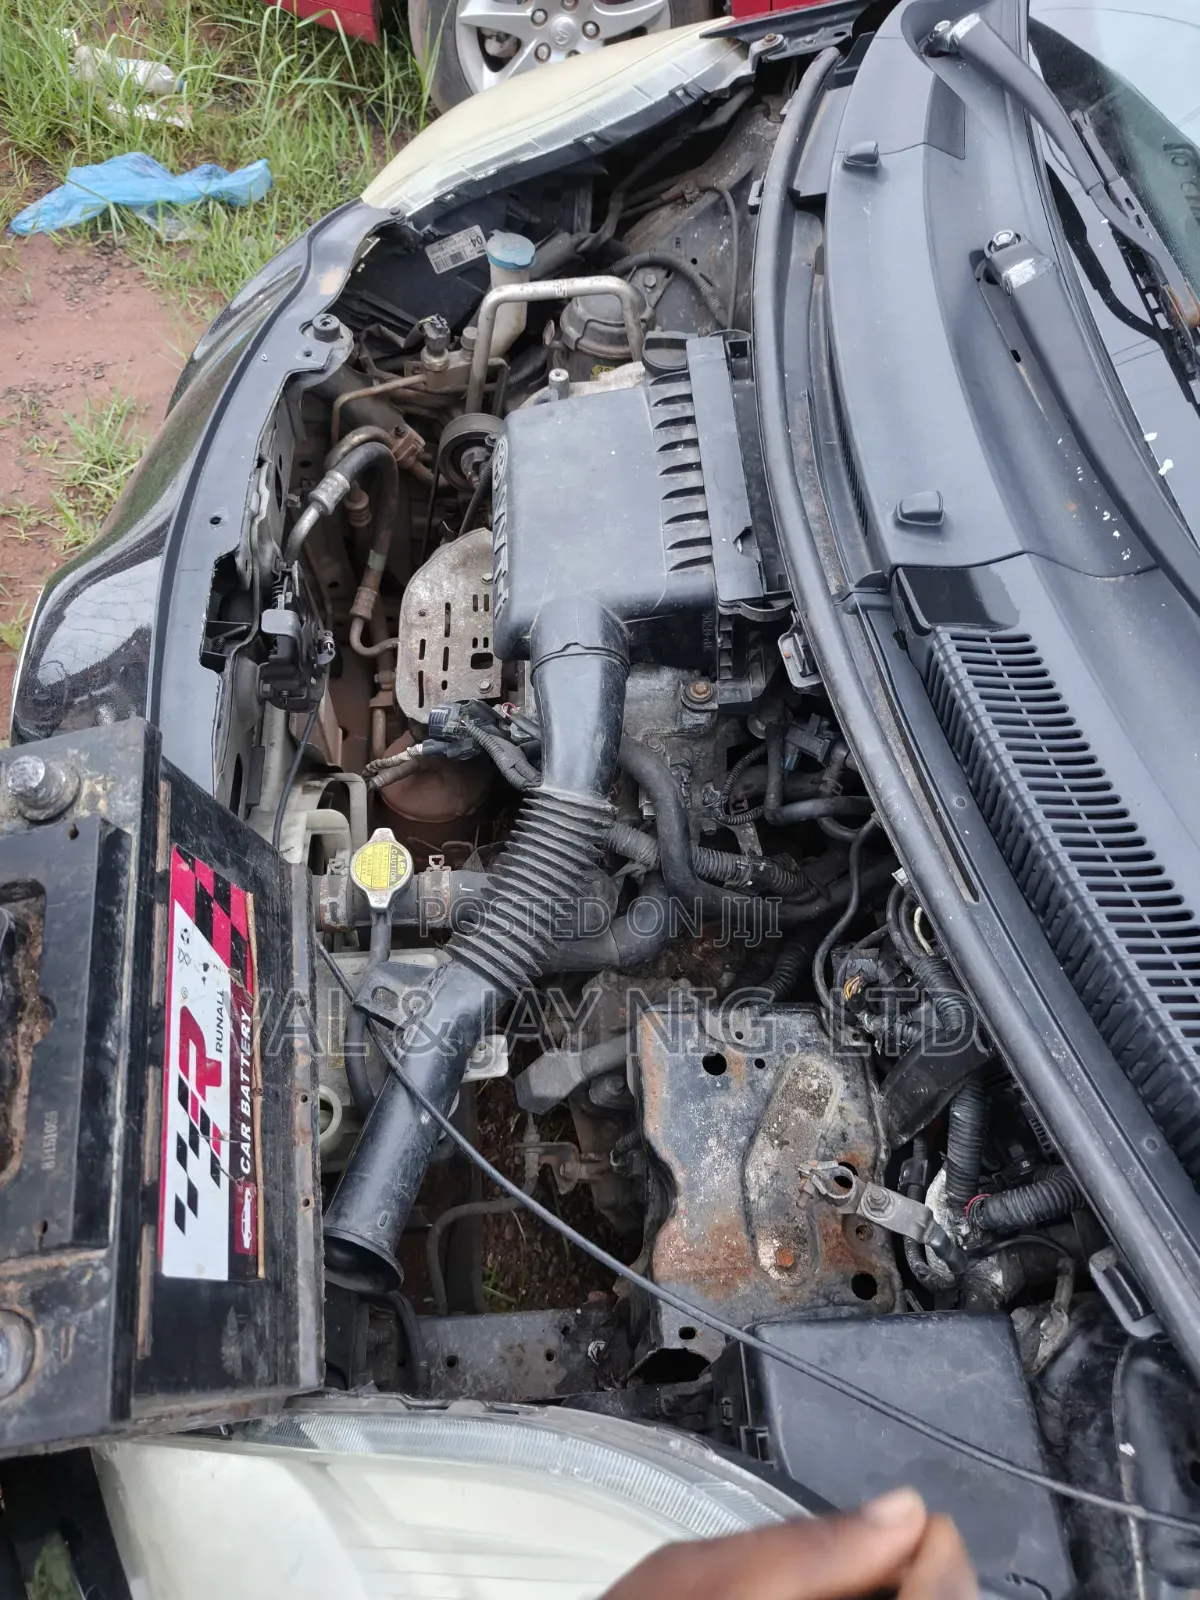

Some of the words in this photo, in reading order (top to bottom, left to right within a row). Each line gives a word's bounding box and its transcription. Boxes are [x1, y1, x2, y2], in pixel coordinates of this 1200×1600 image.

[390, 848, 398, 882] CAUTION
[215, 988, 225, 1053] RUNALL
[240, 1006, 251, 1118] BATTERY
[240, 1122, 251, 1174] CAR
